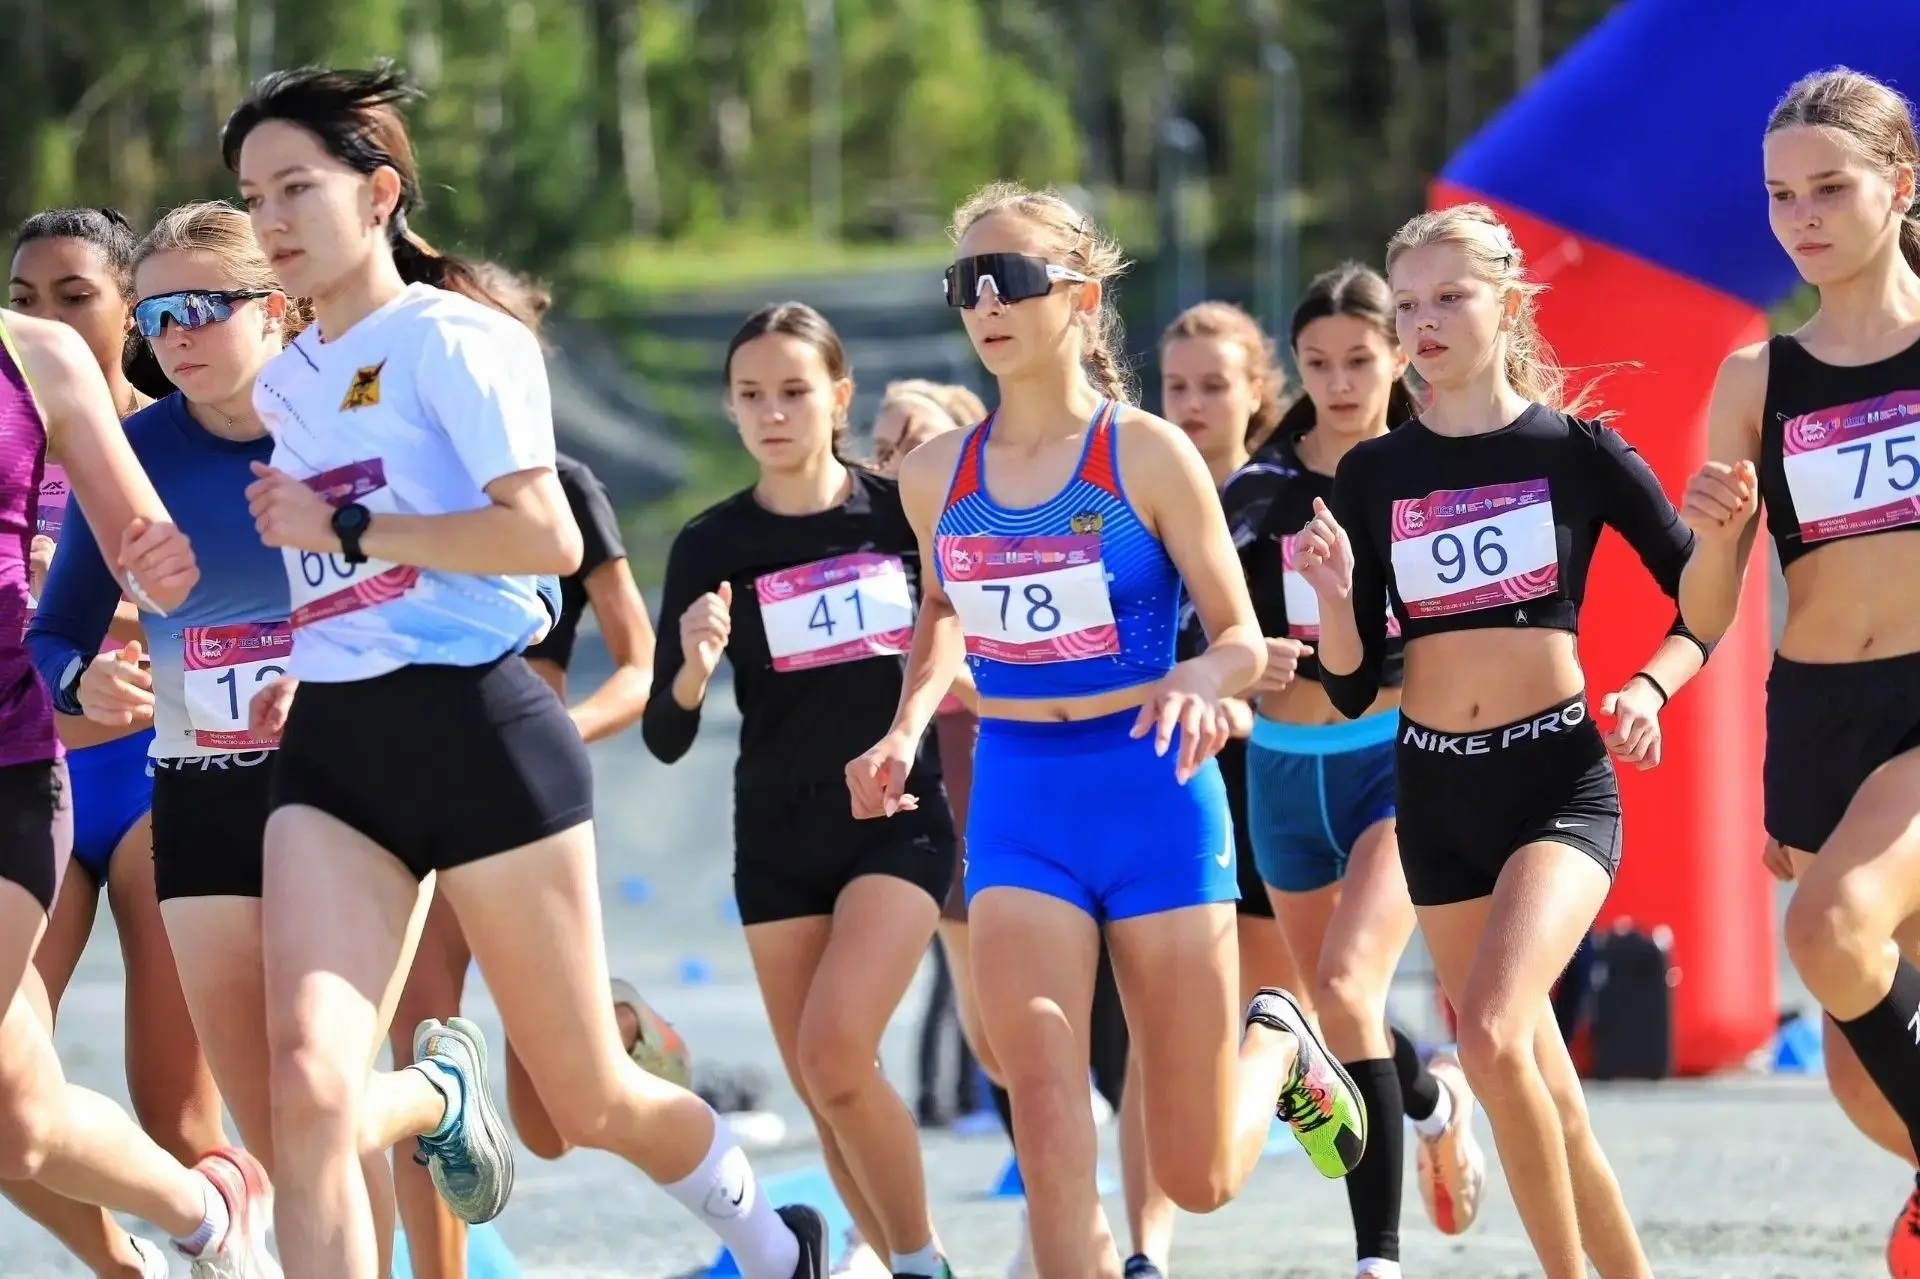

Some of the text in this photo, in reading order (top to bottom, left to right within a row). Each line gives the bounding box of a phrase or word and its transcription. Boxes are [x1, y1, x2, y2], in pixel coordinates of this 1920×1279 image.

[1837, 436, 1920, 500] 75
[1432, 526, 1508, 584] 96
[808, 588, 865, 637] 41
[982, 584, 1061, 632] 78
[217, 665, 286, 719] 1
[1403, 702, 1586, 755] NIKE PRO
